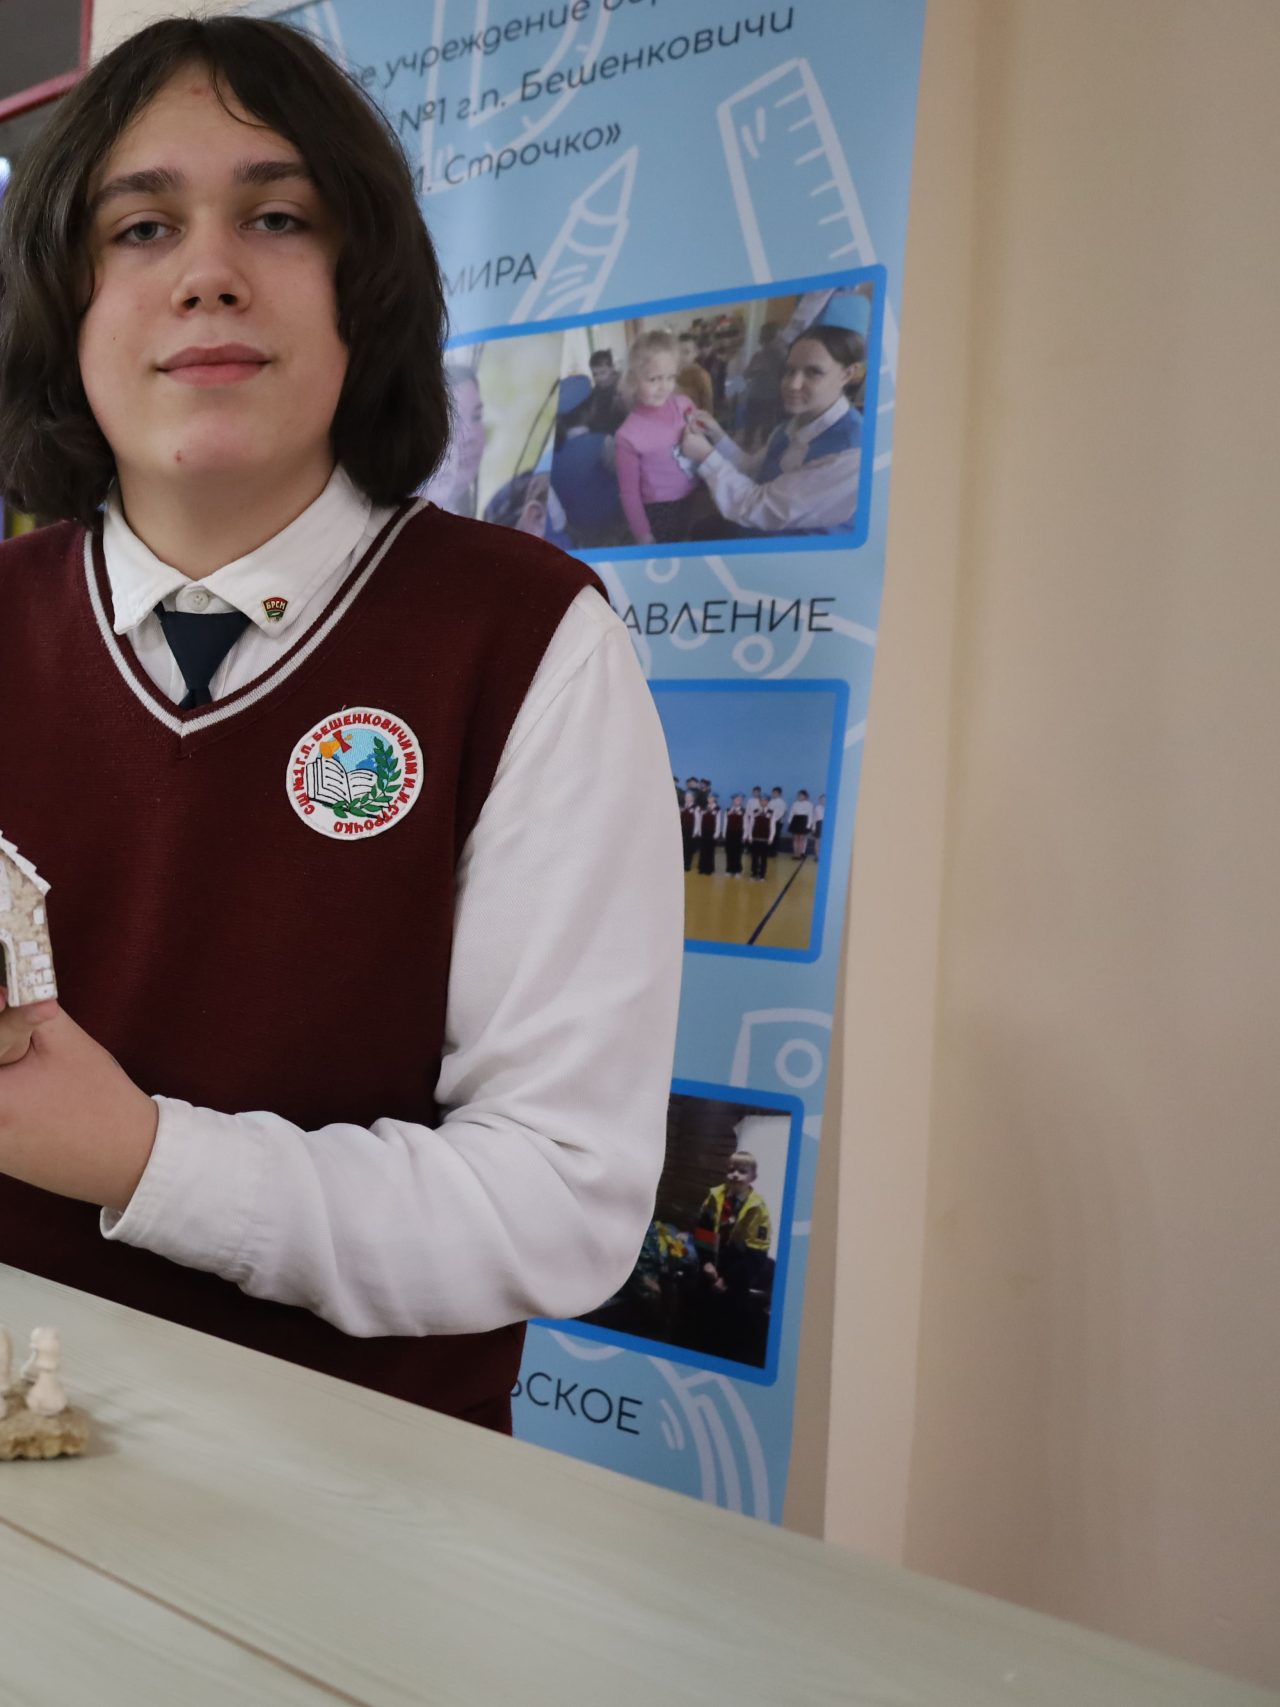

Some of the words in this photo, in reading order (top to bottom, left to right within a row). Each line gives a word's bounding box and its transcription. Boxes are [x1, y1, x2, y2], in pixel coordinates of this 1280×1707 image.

[383, 0, 590, 89] учреждение
[398, 96, 447, 136] №1
[457, 88, 507, 121] г.п.
[520, 6, 795, 102] Бешенковичи
[444, 122, 623, 185] Строчко»
[265, 600, 286, 610] БРСМ
[613, 597, 837, 636] АВЛЕНИЕ
[312, 712, 414, 751] БЕШЕНКОВИЧИ
